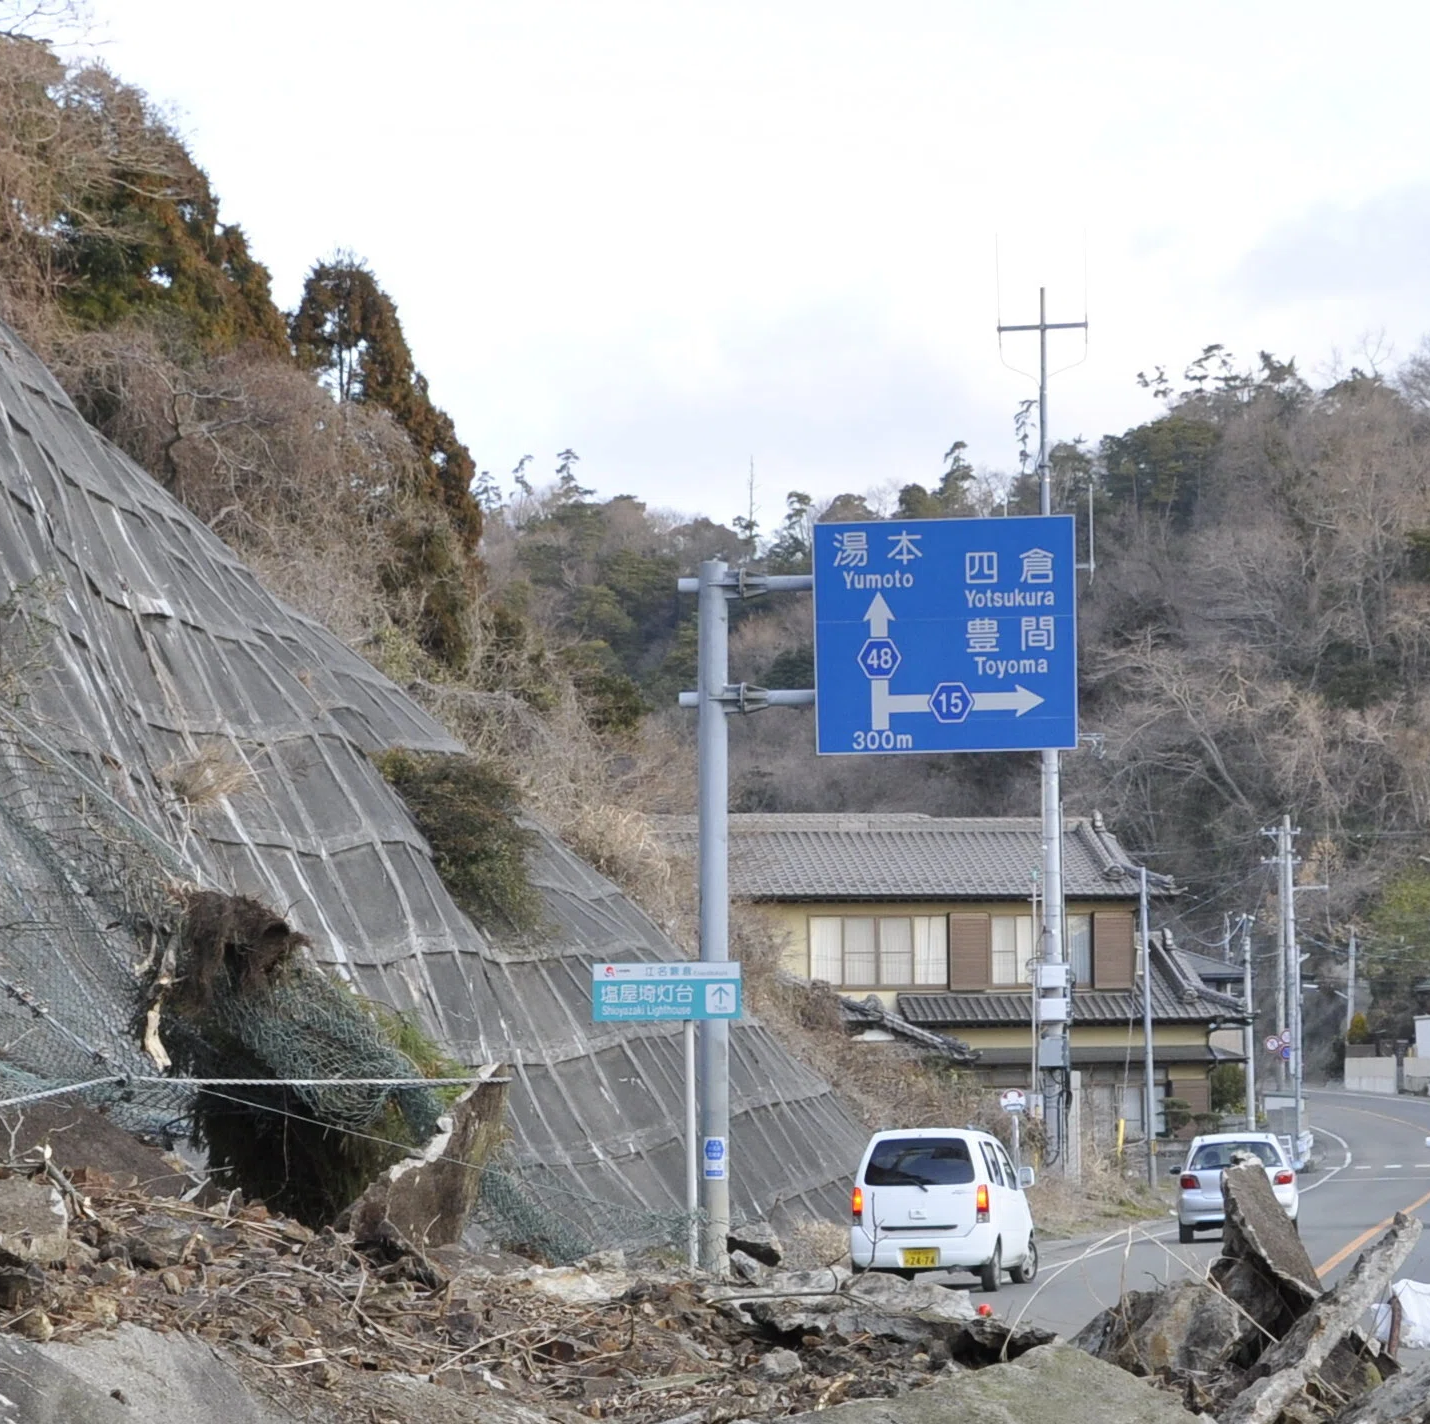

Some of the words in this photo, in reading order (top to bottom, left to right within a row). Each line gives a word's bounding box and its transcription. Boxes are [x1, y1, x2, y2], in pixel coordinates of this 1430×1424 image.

[833, 530, 923, 567] 湯本
[965, 547, 1054, 584] 四倉
[843, 570, 914, 589] Yumoto
[964, 588, 1055, 608] Yotsukura
[965, 615, 1055, 653] 豊間
[867, 648, 893, 669] 48
[973, 656, 1048, 679] Toyoma
[938, 692, 963, 713] 15
[852, 730, 913, 750] 300m
[647, 1004, 692, 1017] Lighthouse
